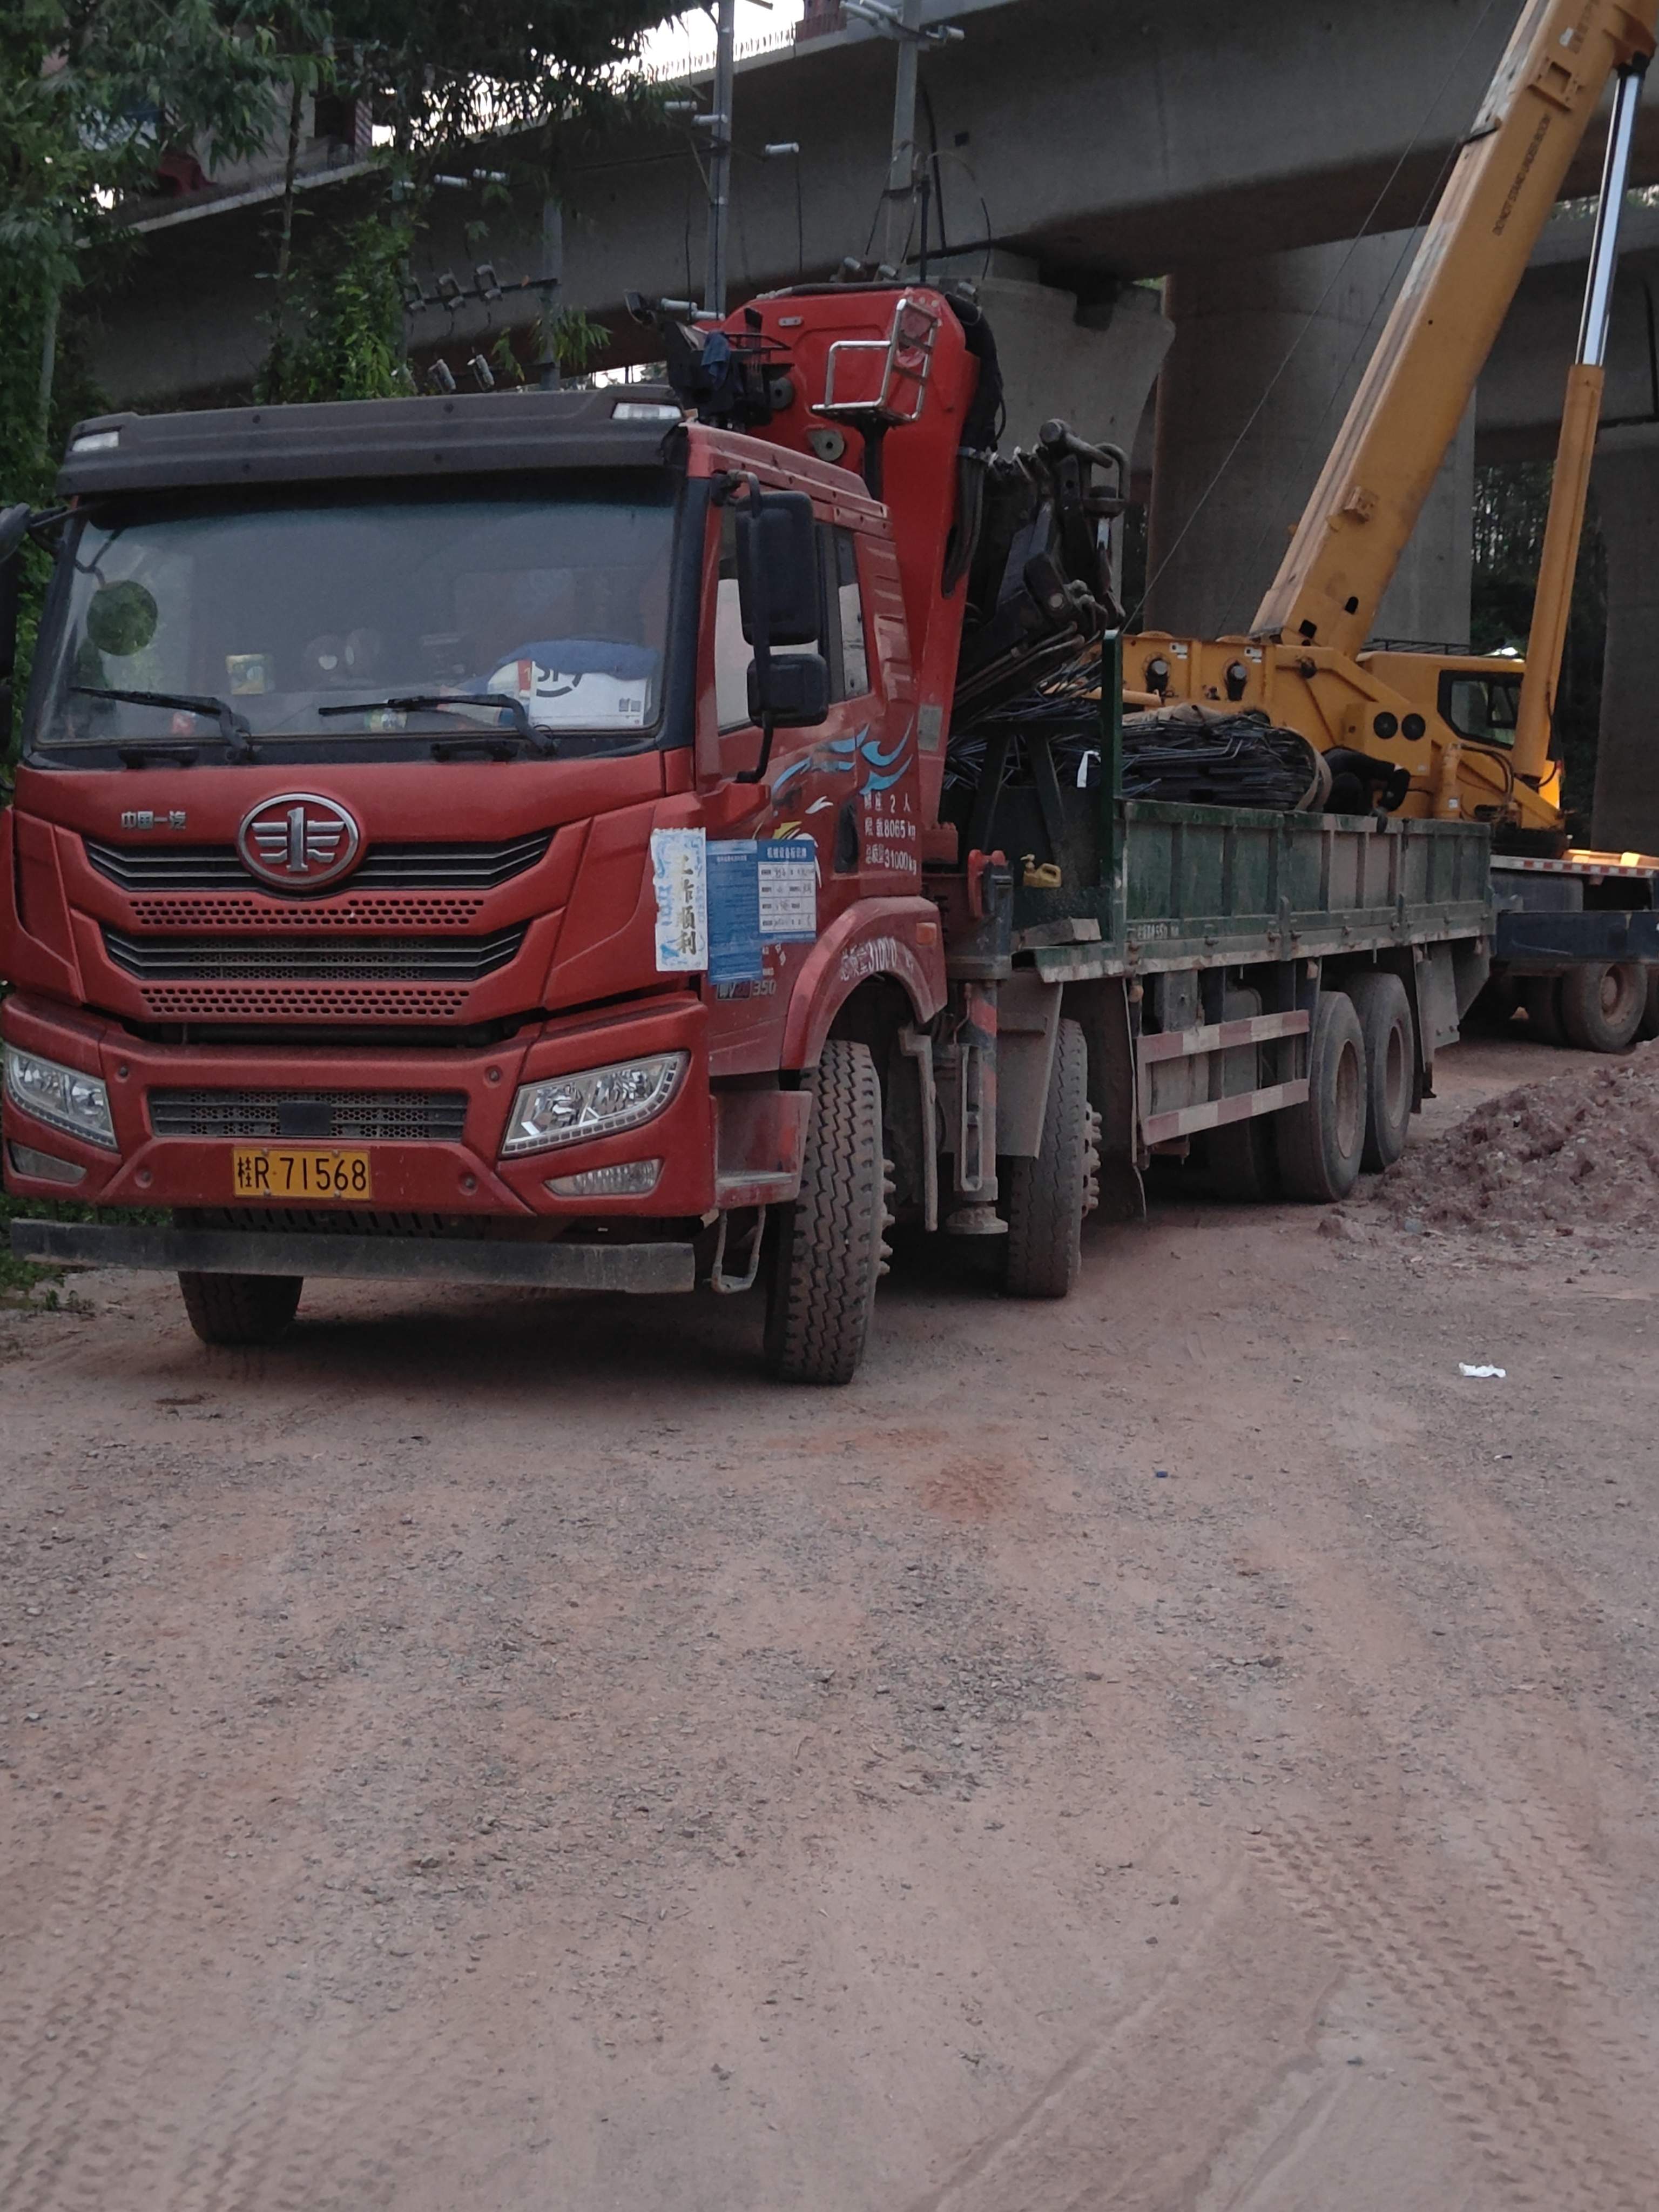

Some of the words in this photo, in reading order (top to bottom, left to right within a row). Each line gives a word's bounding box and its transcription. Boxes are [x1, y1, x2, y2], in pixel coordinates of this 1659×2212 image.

[121, 811, 186, 830] 中国一汽
[752, 979, 777, 996] 350
